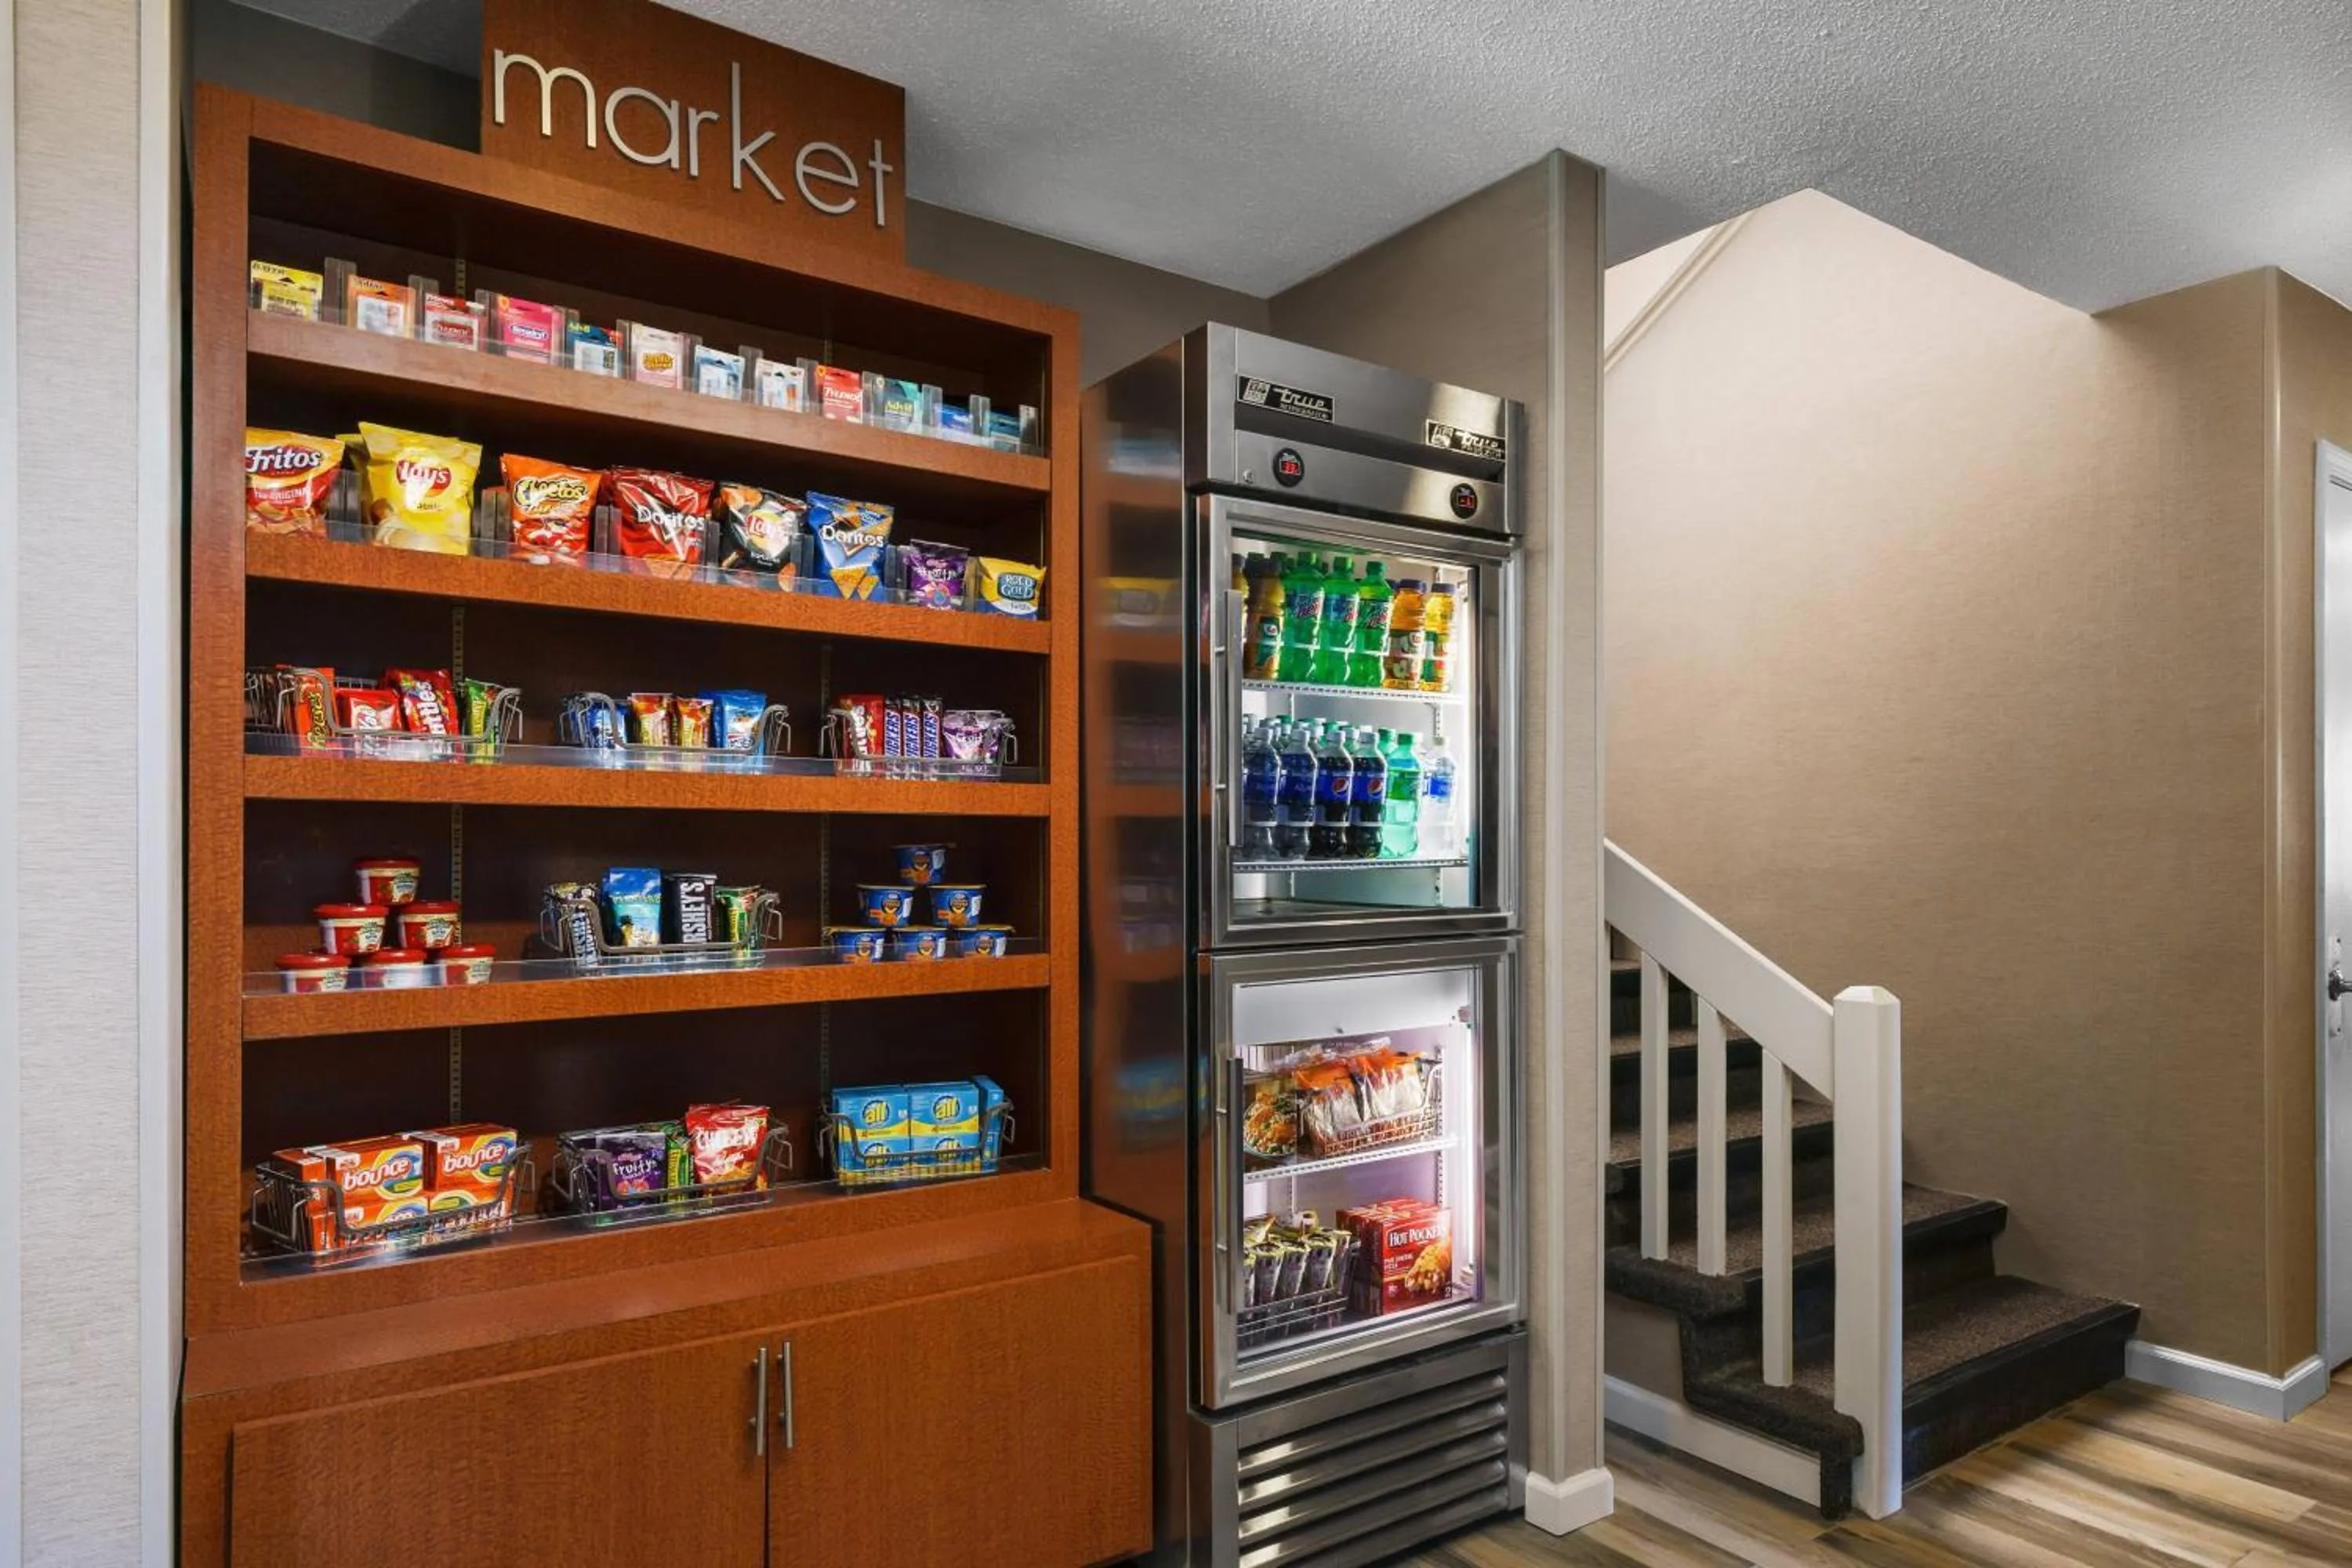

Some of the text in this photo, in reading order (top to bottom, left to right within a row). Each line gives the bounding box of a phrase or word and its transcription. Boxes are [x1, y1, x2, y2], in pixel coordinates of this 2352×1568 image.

[494, 48, 894, 228] market
[245, 445, 322, 473] Fritos
[637, 505, 706, 532] Doritos
[821, 524, 884, 548] Doritos
[681, 880, 706, 943] RSHEY'S
[865, 1102, 887, 1123] all
[935, 1098, 957, 1120] all
[445, 1144, 506, 1174] bounce
[612, 1160, 652, 1175] Fruity
[343, 1157, 411, 1192] bounce
[1390, 1230, 1408, 1247] HOT
